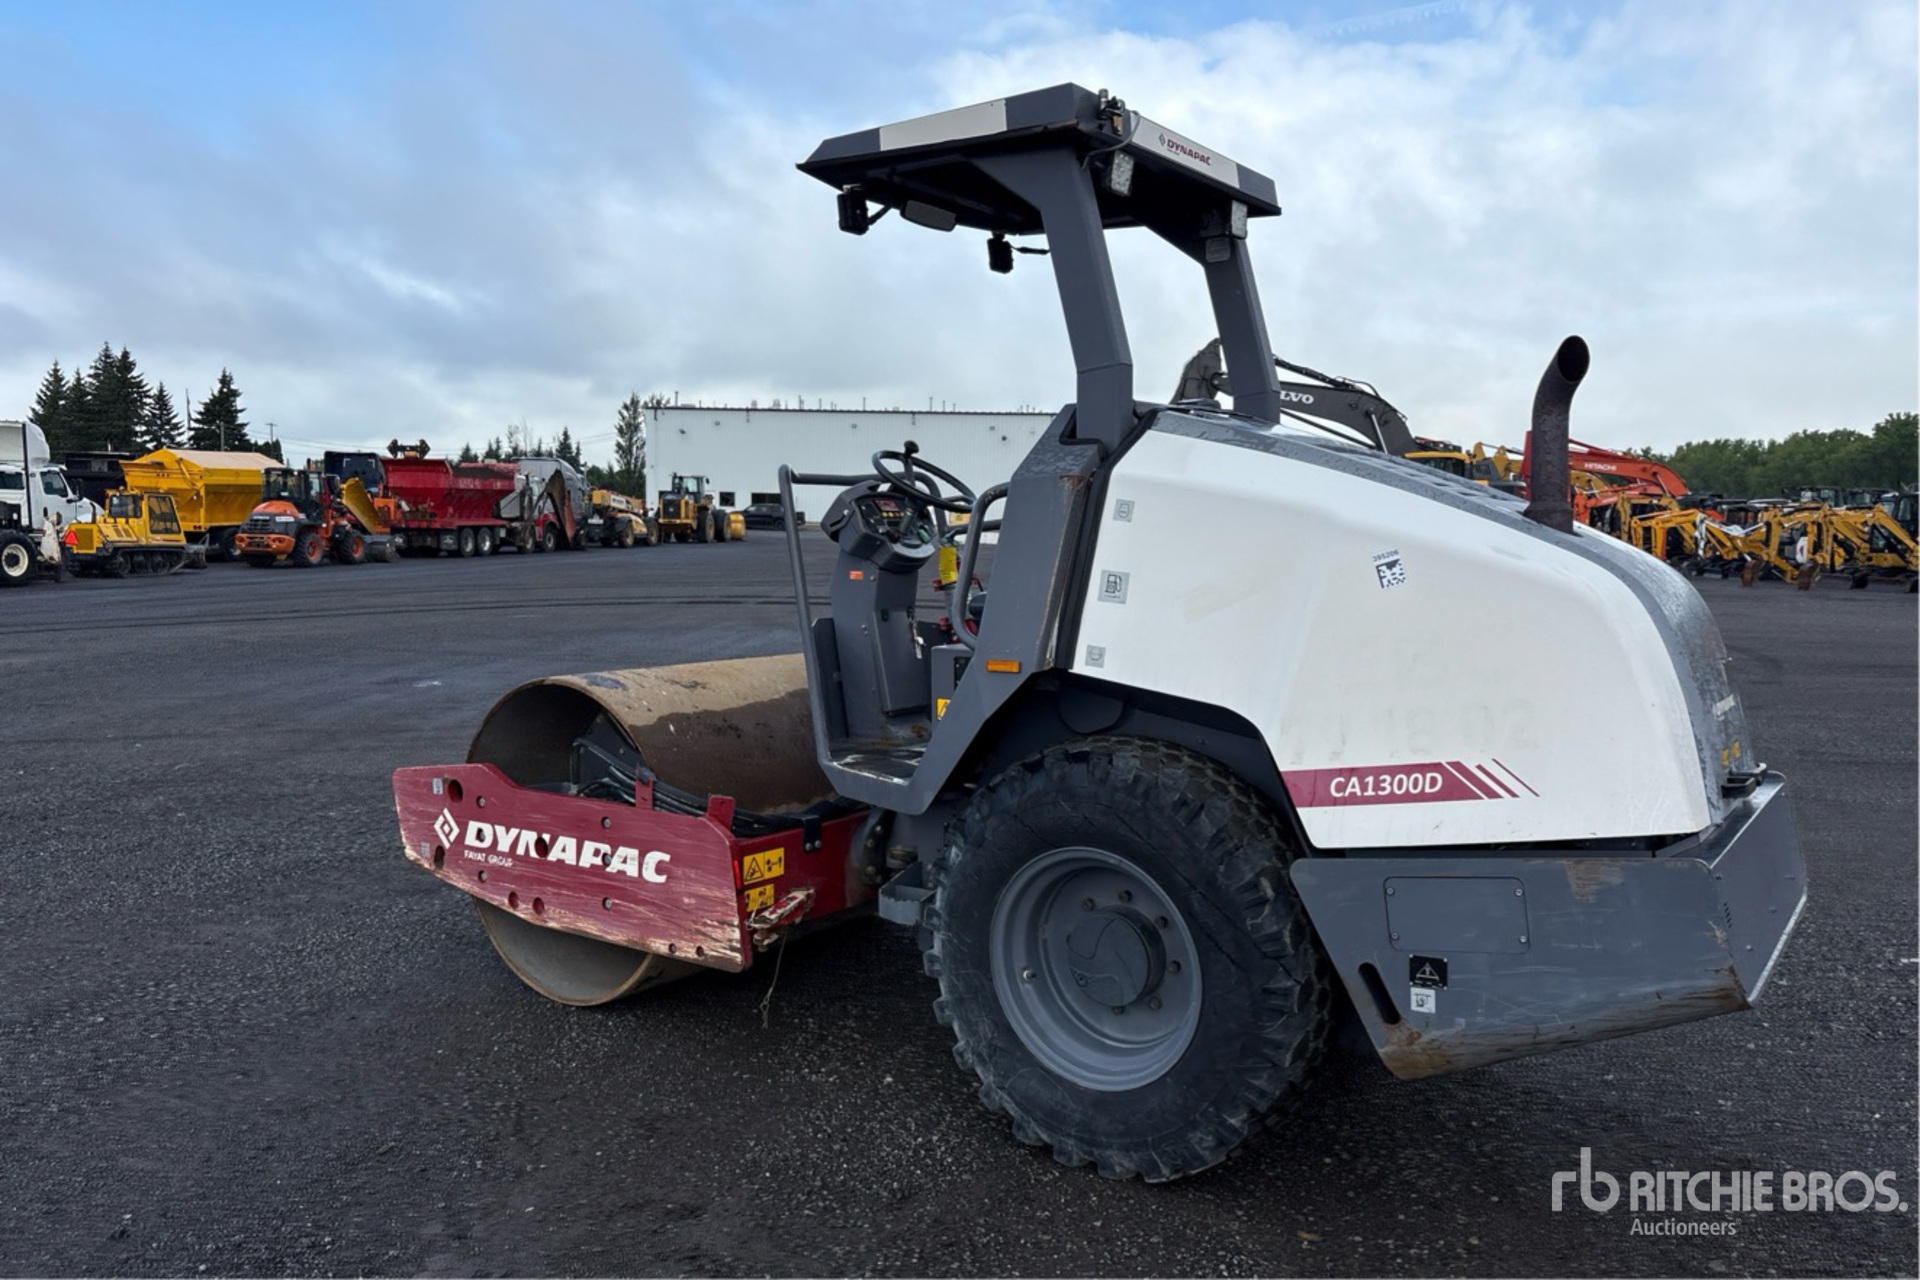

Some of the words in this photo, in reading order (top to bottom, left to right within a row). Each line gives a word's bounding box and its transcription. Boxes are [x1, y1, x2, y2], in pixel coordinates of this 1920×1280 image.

[1167, 139, 1211, 166] DYNAPAC
[1280, 390, 1314, 404] LVO
[1584, 462, 1617, 470] HITACHI
[1372, 549, 1399, 562] 395206
[1330, 772, 1443, 798] CA1300D
[464, 820, 671, 883] DYNAPAC
[464, 850, 486, 862] FAYAT
